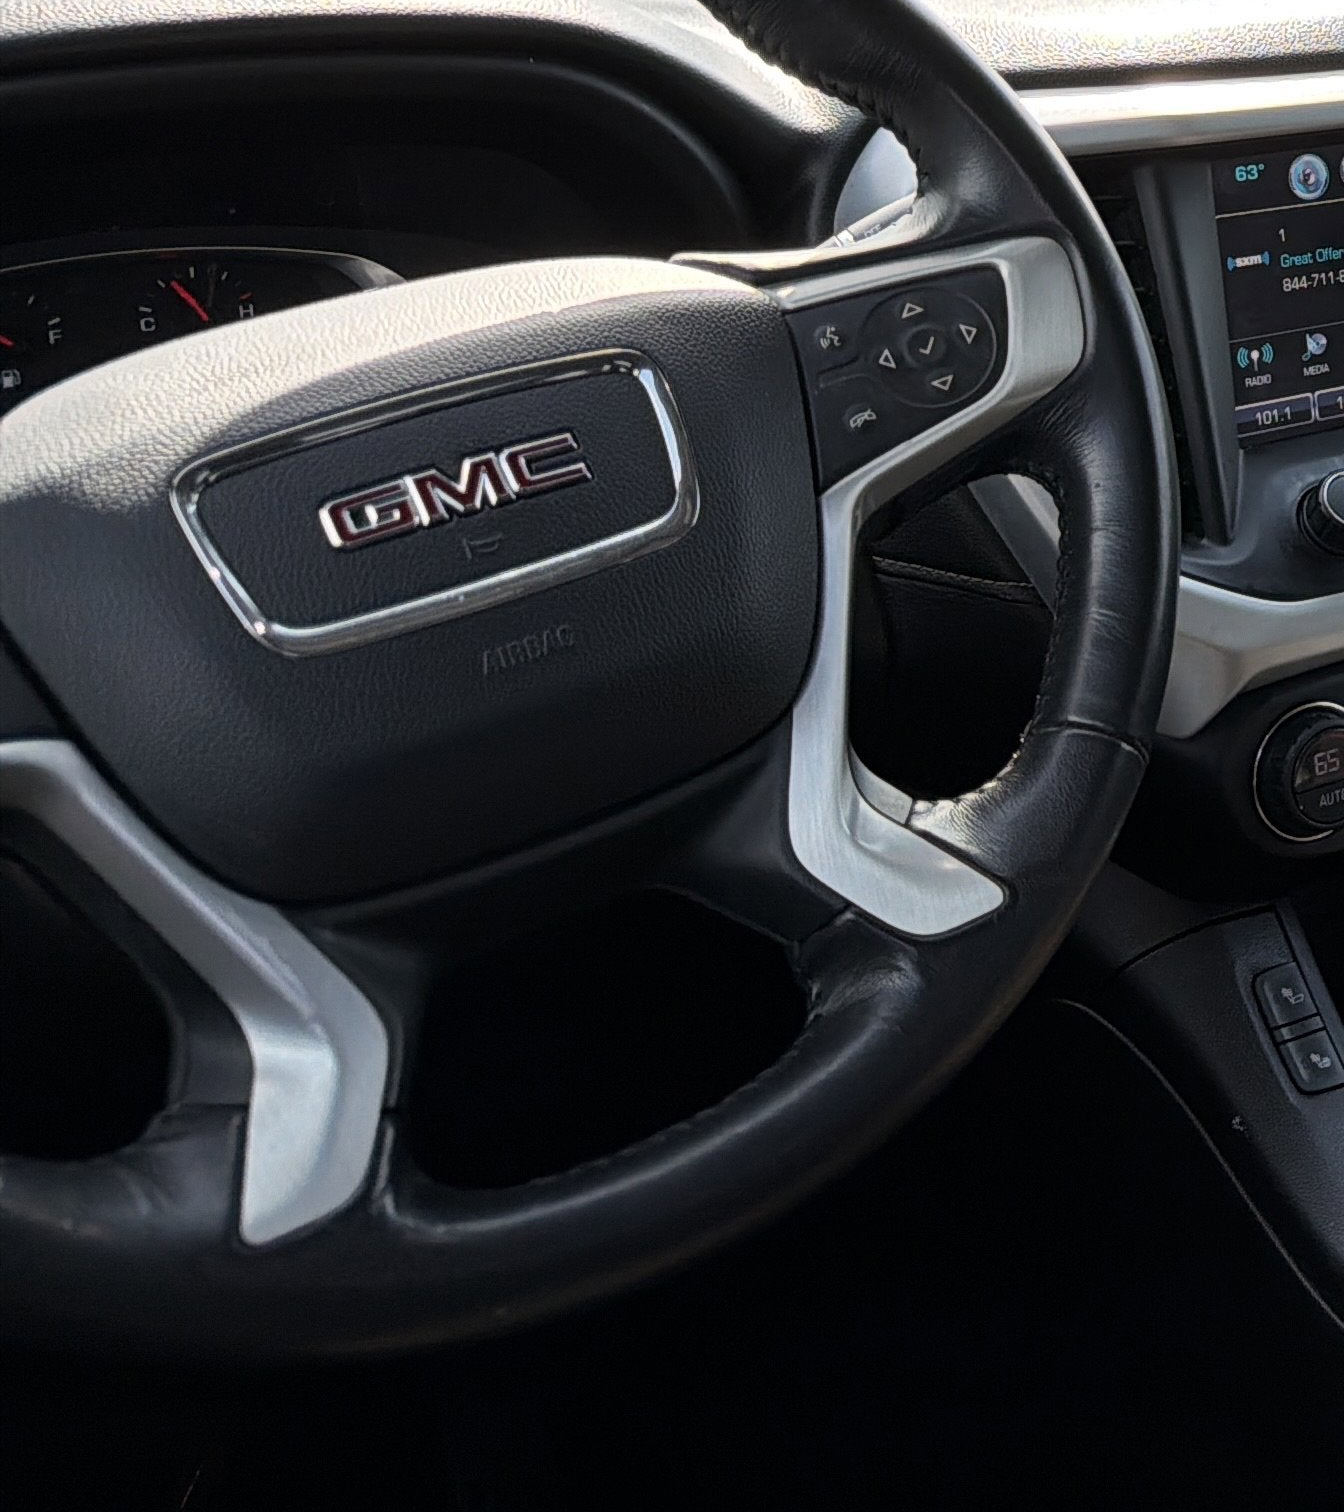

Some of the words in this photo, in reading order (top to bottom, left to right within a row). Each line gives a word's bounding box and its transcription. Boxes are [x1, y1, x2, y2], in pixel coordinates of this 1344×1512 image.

[1234, 163, 1265, 182] 63°
[1278, 228, 1286, 242] 1
[1280, 252, 1313, 268] Great
[1315, 248, 1344, 263] Offer
[238, 303, 254, 319] H
[139, 317, 156, 332] C
[48, 329, 62, 345] F
[1302, 363, 1330, 377] MEDIA
[1245, 374, 1272, 388] RADIO
[1255, 406, 1292, 427] 101.1
[318, 431, 594, 548] GMC
[482, 623, 577, 675] AIRBAG
[1313, 748, 1341, 777] 65
